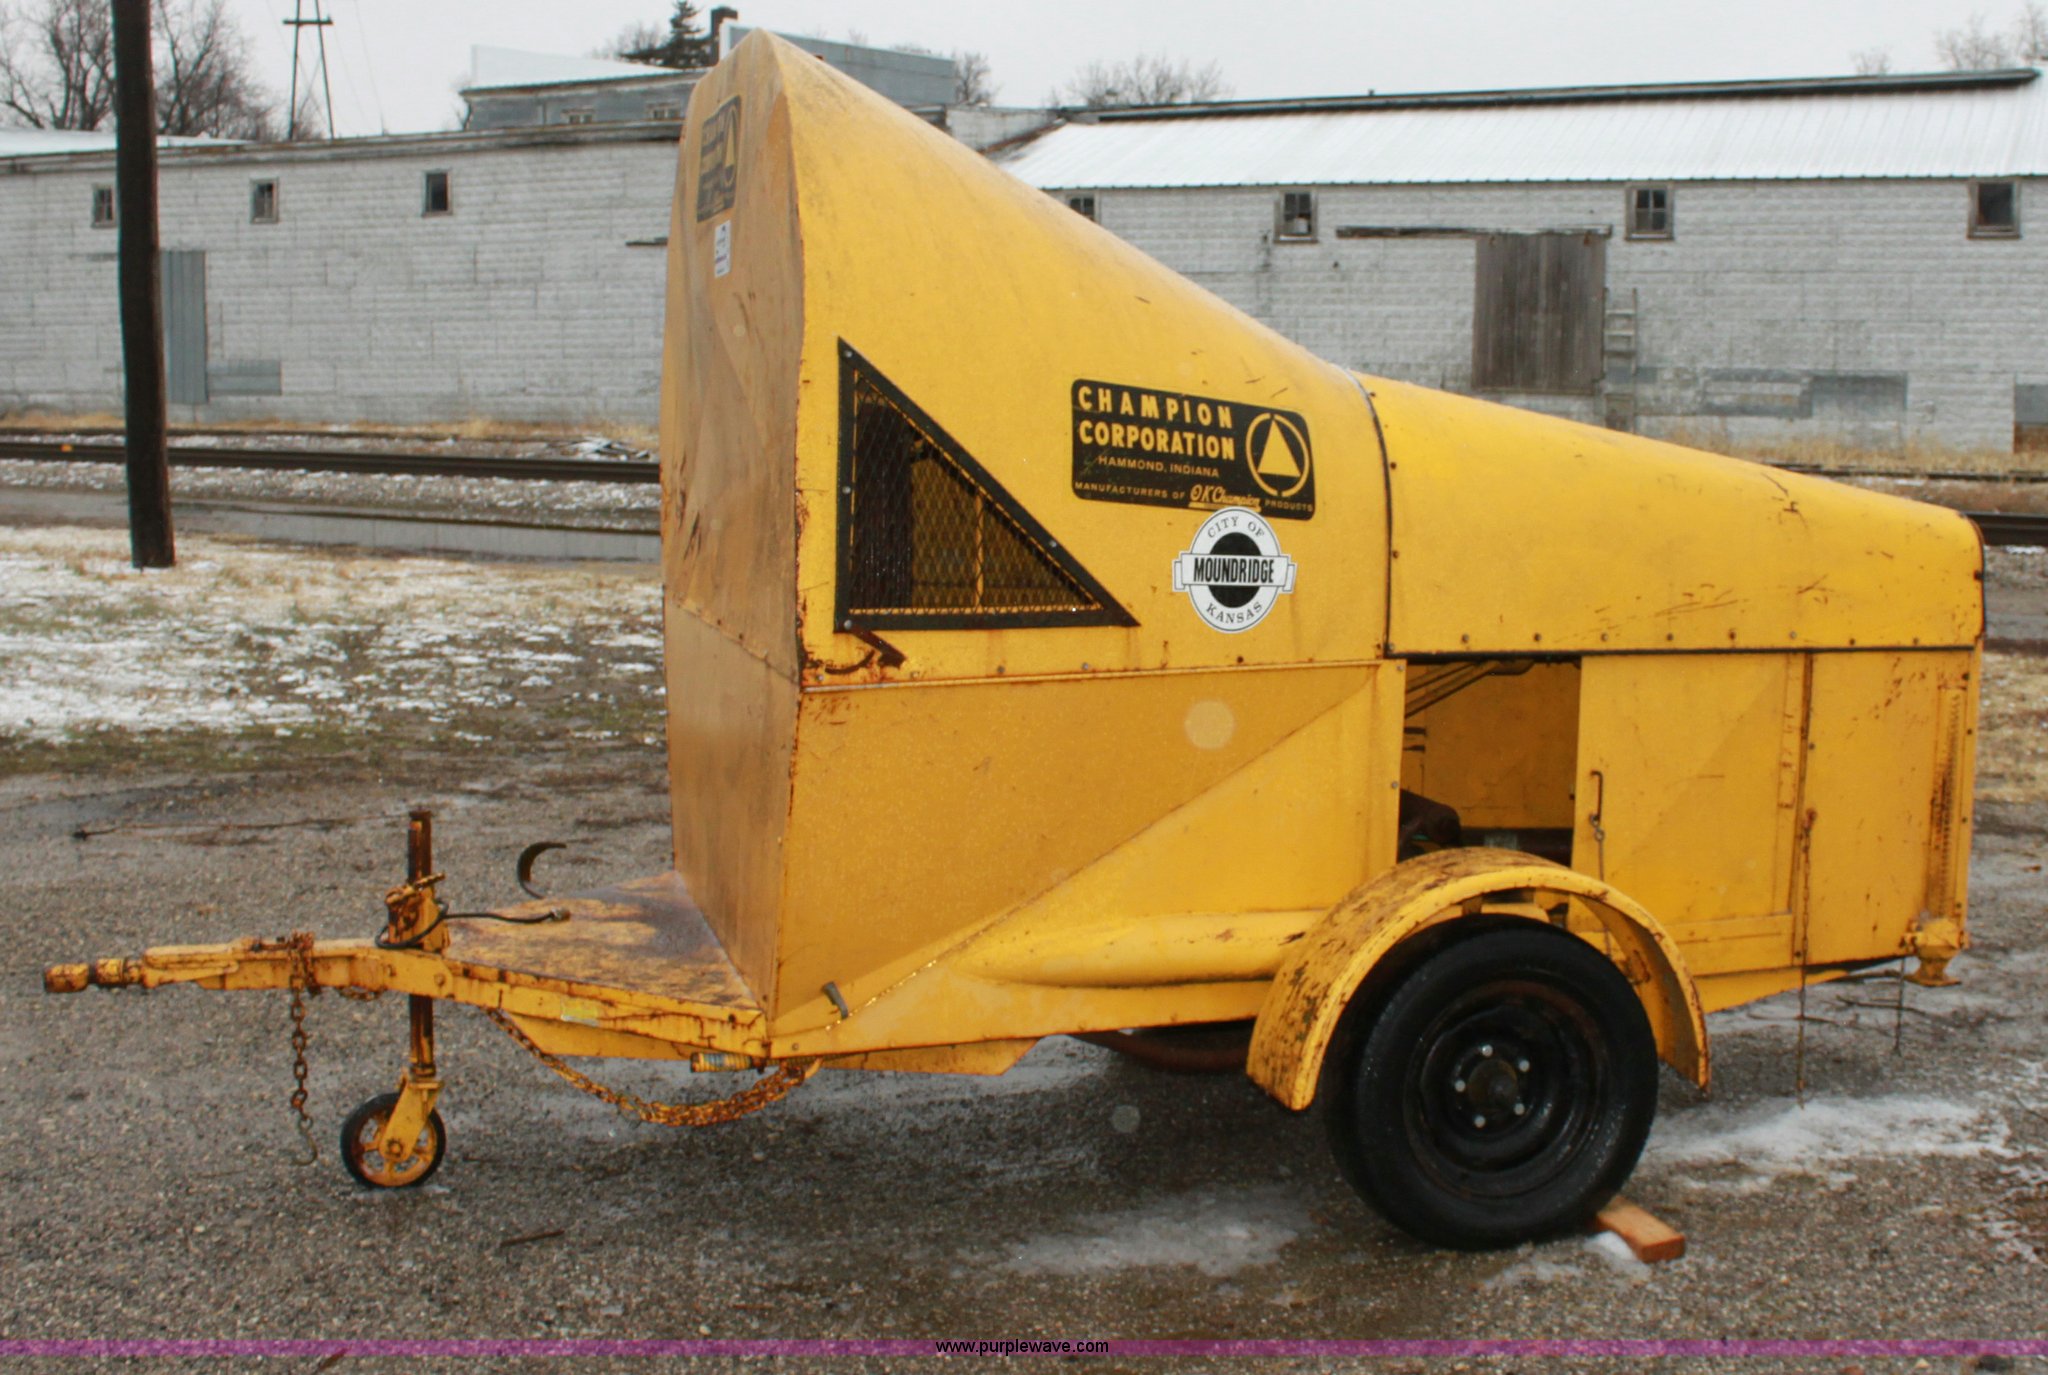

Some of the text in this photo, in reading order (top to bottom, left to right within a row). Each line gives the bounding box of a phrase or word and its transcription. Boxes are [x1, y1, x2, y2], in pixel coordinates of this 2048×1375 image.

[1078, 386, 1233, 428] CHAMPION
[1079, 420, 1236, 460] CORPORATION
[1169, 464, 1219, 477] INDIANA
[1075, 481, 1168, 499] MANUFACTURERS
[1172, 490, 1185, 499] OF
[1264, 499, 1313, 512] PRODUCTS
[1207, 516, 1265, 539] CITY OF
[1193, 557, 1274, 584] MOUNDRIDGE
[1205, 602, 1263, 624] KANSAS
